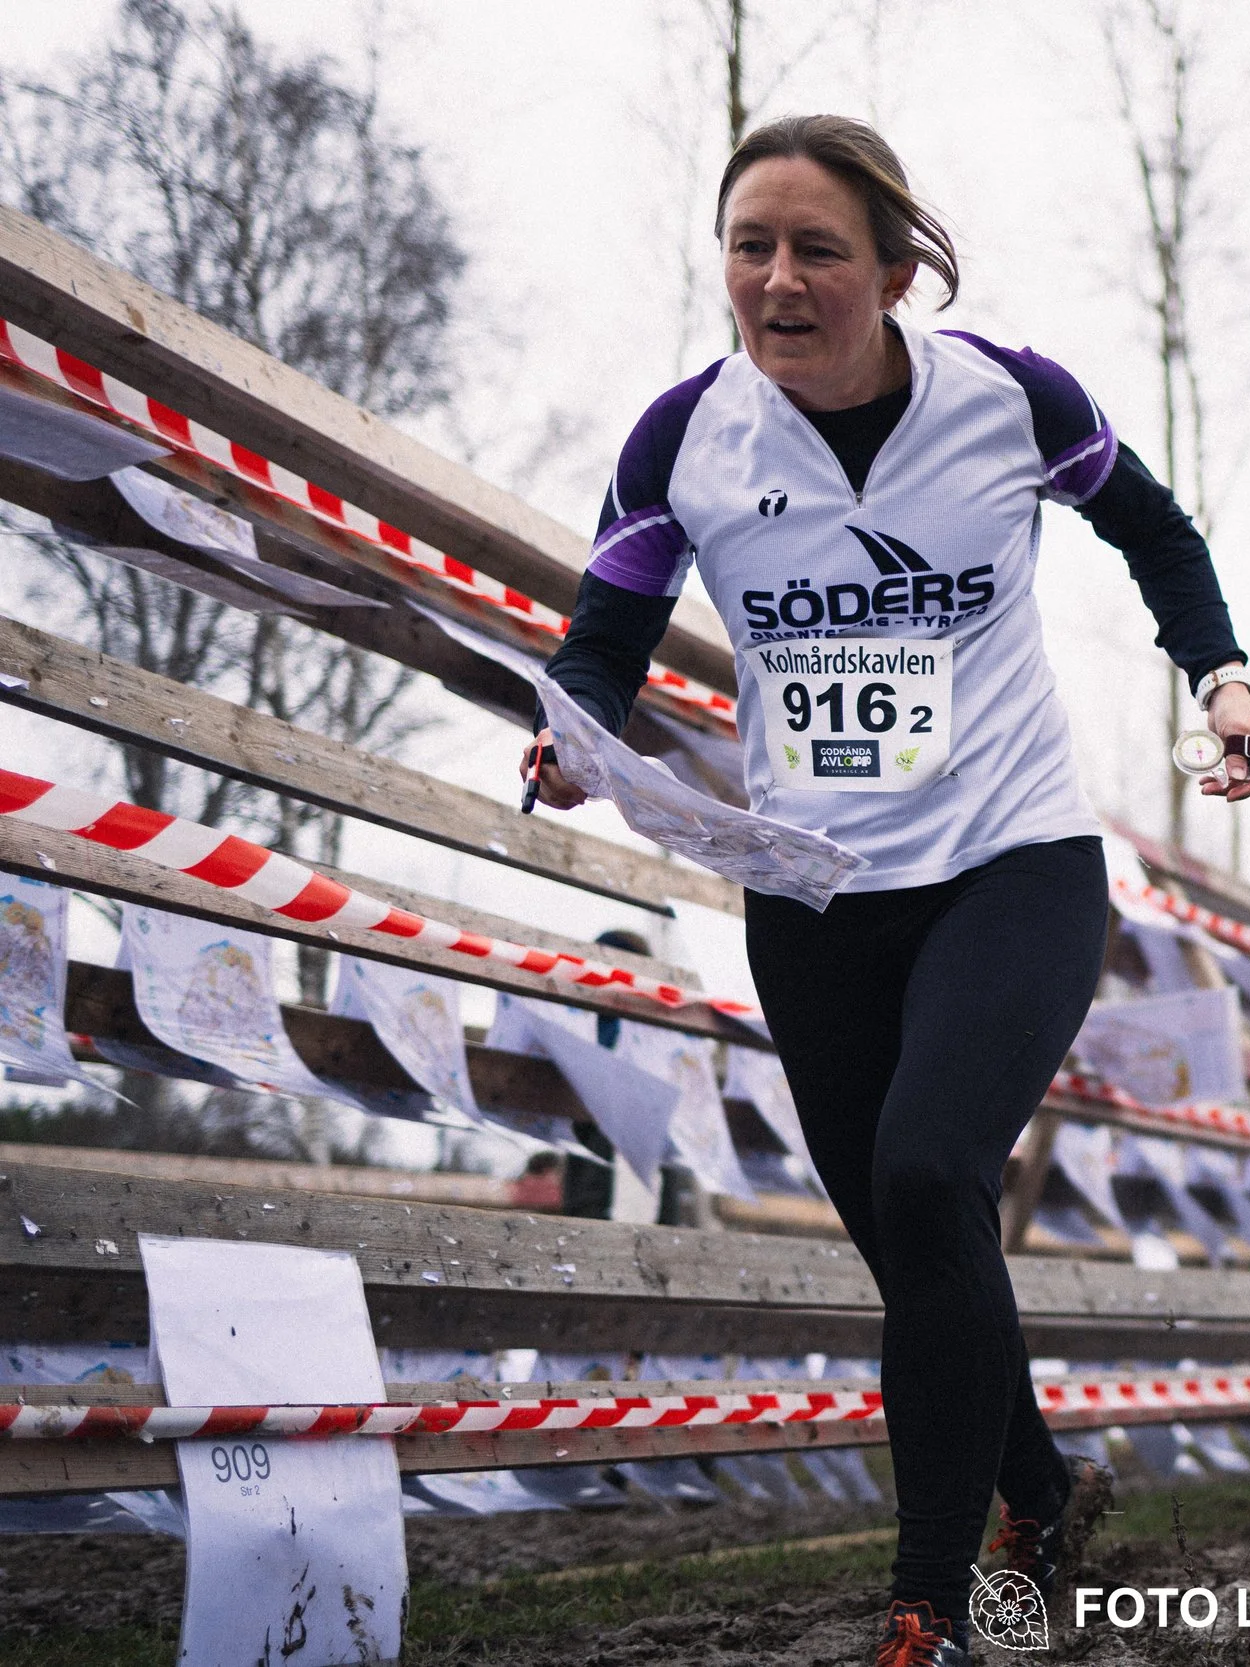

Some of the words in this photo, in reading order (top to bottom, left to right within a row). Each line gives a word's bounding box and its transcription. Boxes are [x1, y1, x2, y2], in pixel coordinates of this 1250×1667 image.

[742, 563, 995, 630] SÖDERS
[759, 645, 935, 675] Kolmårdskavlen
[782, 681, 898, 733] 916
[909, 705, 933, 733] 2
[820, 746, 872, 756] GODKÄNDA
[211, 1443, 271, 1483] 909
[254, 1485, 260, 1495] 2
